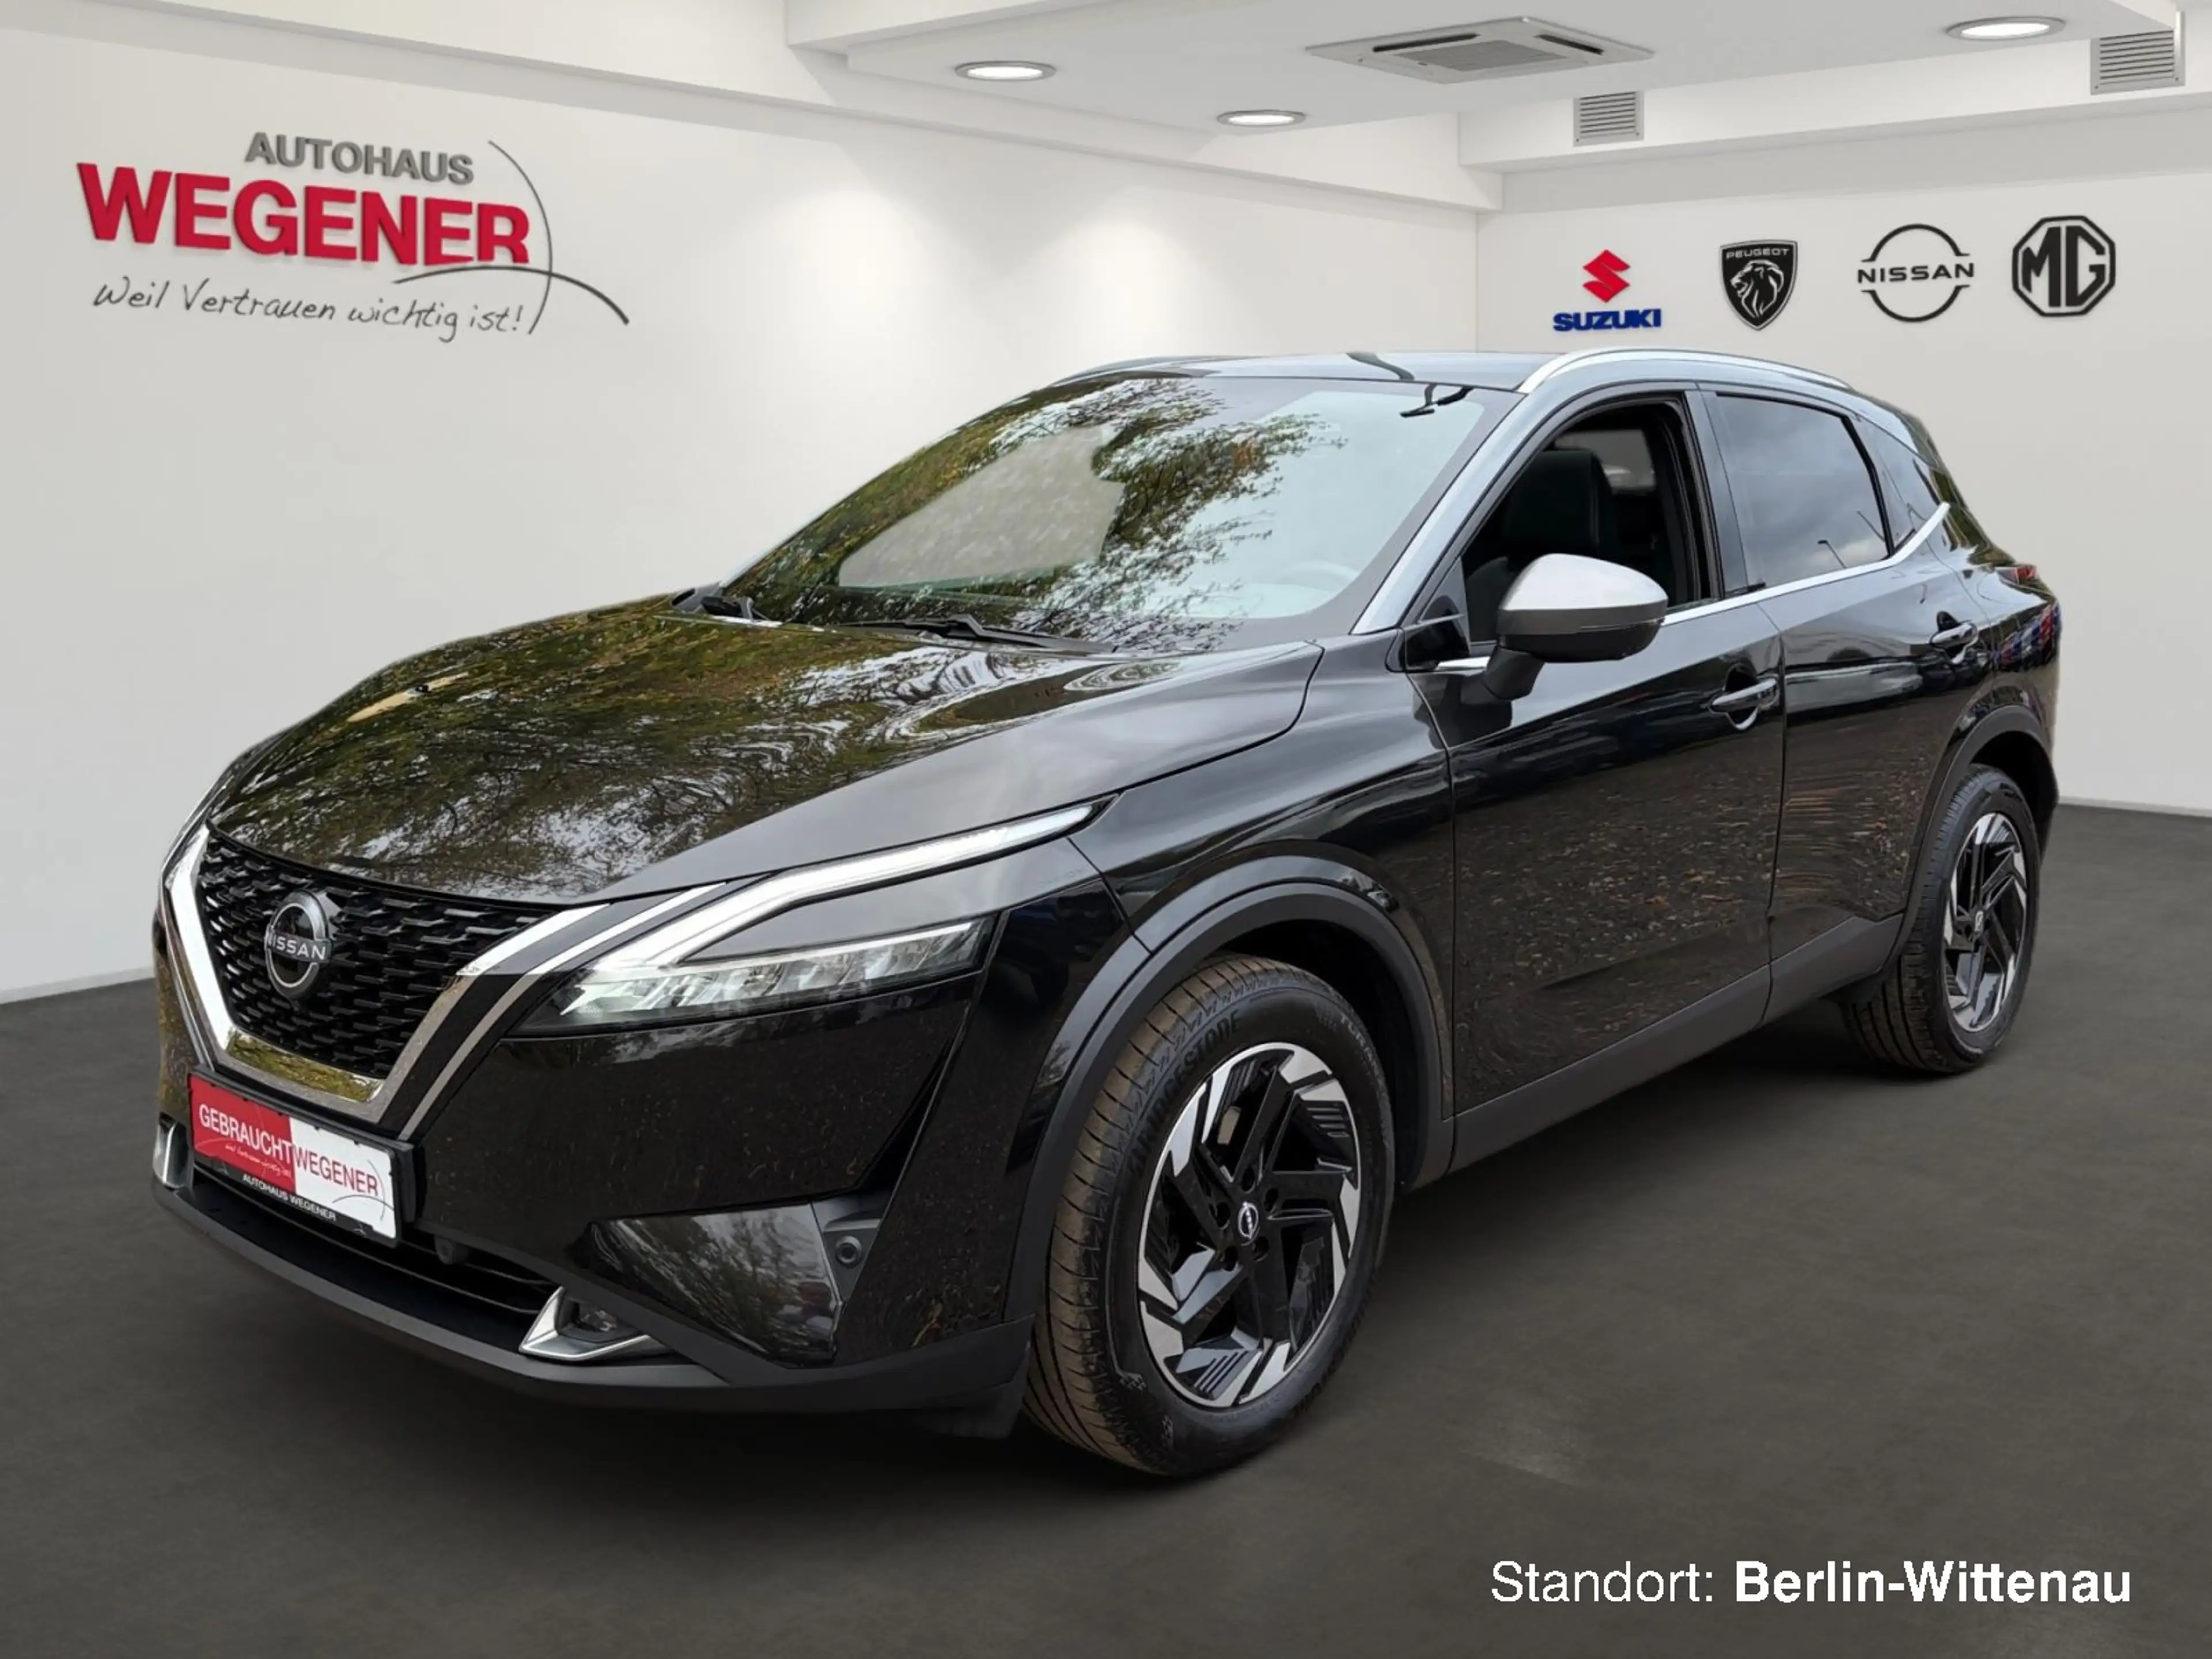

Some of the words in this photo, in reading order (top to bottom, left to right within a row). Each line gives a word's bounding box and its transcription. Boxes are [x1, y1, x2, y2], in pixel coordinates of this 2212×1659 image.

[245, 132, 475, 185] AUTOHAUS
[77, 162, 530, 266] WEGENER
[1726, 248, 1790, 259] PEUGEOT
[1857, 263, 1975, 284] NISSAN
[2022, 225, 2106, 308] MG
[93, 276, 171, 309] Weil
[183, 278, 336, 321] Vertrauen
[347, 298, 458, 343] wichtig
[470, 304, 524, 332] ist!
[1552, 308, 1662, 332] SUZUKI
[243, 1173, 288, 1200] AUTOHAUS
[289, 1194, 337, 1222] WEGENER
